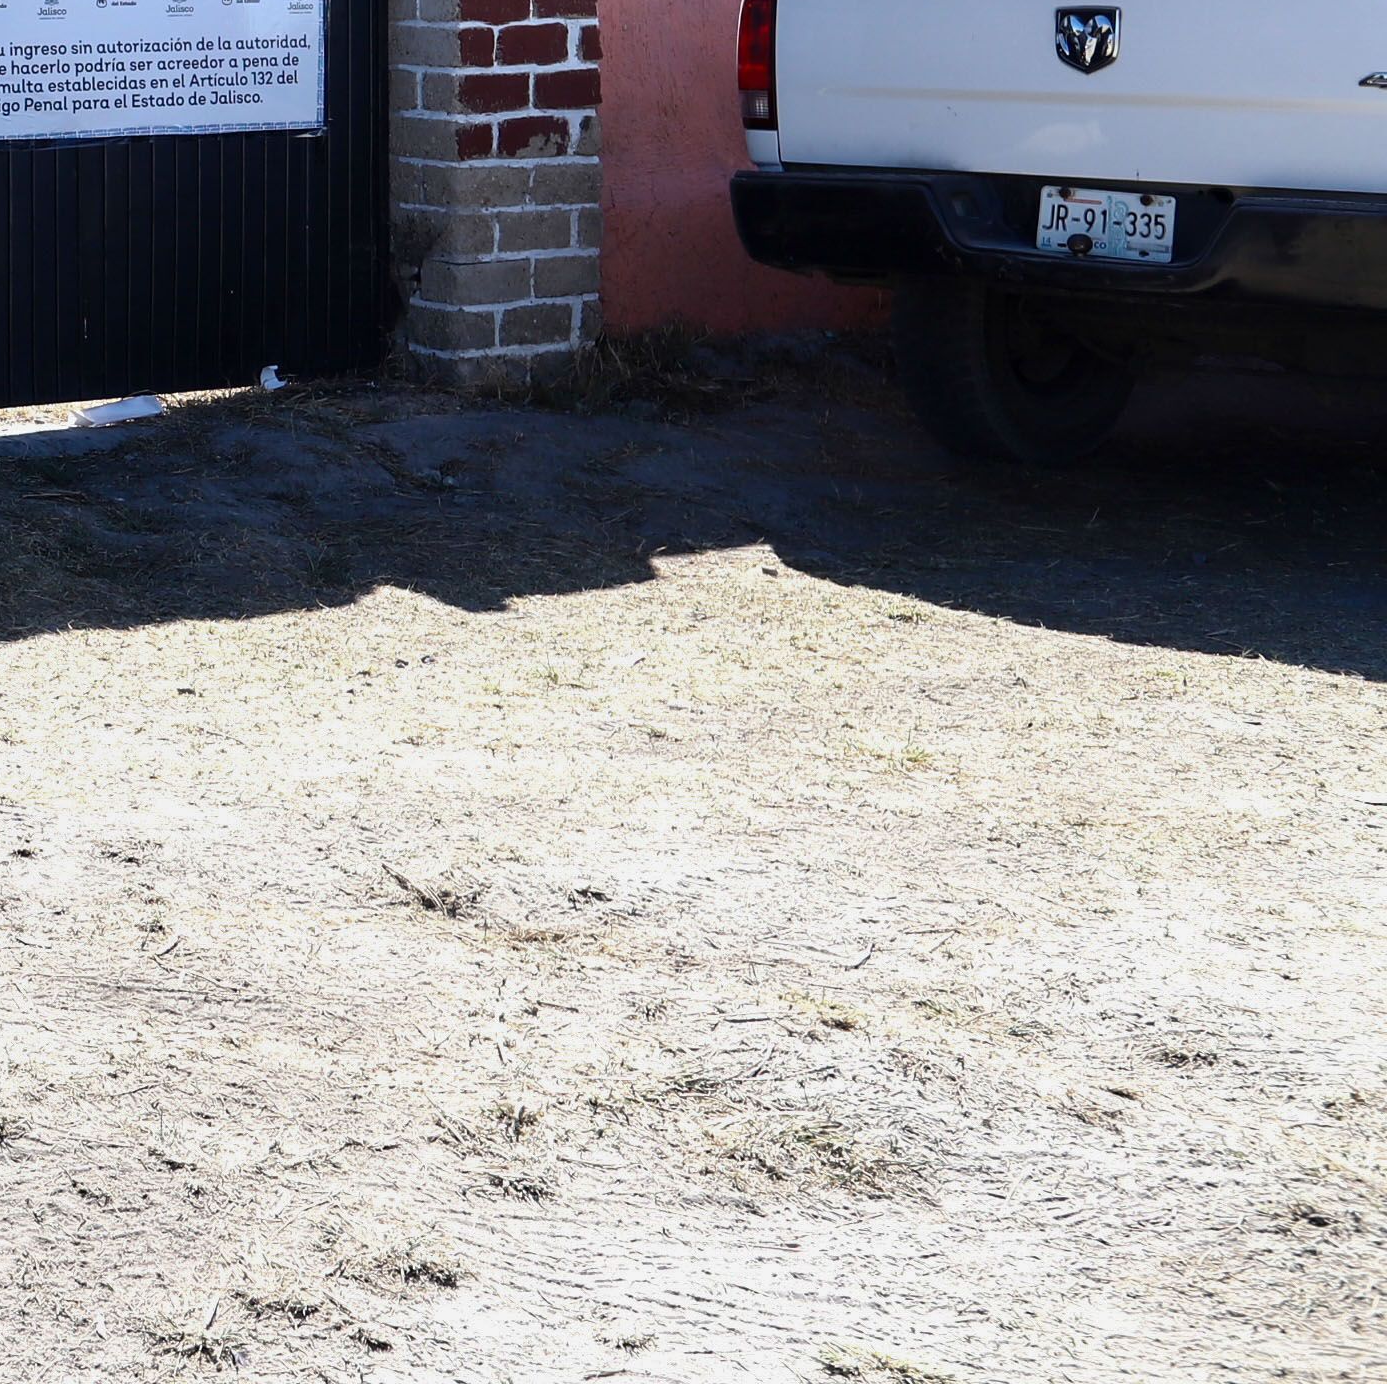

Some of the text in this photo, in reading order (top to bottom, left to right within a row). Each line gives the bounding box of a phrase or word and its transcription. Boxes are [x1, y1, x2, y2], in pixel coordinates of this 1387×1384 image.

[37, 7, 67, 15] Jalisco
[166, 5, 194, 13] Jalisco
[287, 2, 313, 10] Jalisco
[10, 42, 67, 61] ingreso
[71, 40, 92, 54] sin
[97, 38, 192, 53] autorización
[196, 37, 214, 51] de
[218, 36, 231, 50] la
[236, 34, 310, 49] autoridad,
[11, 59, 70, 75] hacerlo
[75, 58, 126, 77] podría
[130, 61, 153, 71] ser
[157, 55, 224, 70] acreedor
[229, 58, 238, 68] a
[242, 57, 278, 72] pena
[283, 52, 299, 66] de
[48, 75, 146, 92] establecidas
[151, 79, 168, 89] en
[173, 74, 185, 88] el
[190, 72, 248, 87] Artículo
[251, 71, 272, 85] 132
[277, 70, 298, 84] del
[25, 96, 67, 111] Penal
[72, 99, 110, 114] para
[114, 94, 127, 108] el
[132, 92, 184, 107] Estado
[189, 91, 206, 105] de
[210, 90, 263, 104] Jalisco.
[1042, 204, 1166, 240] JR-91-335
